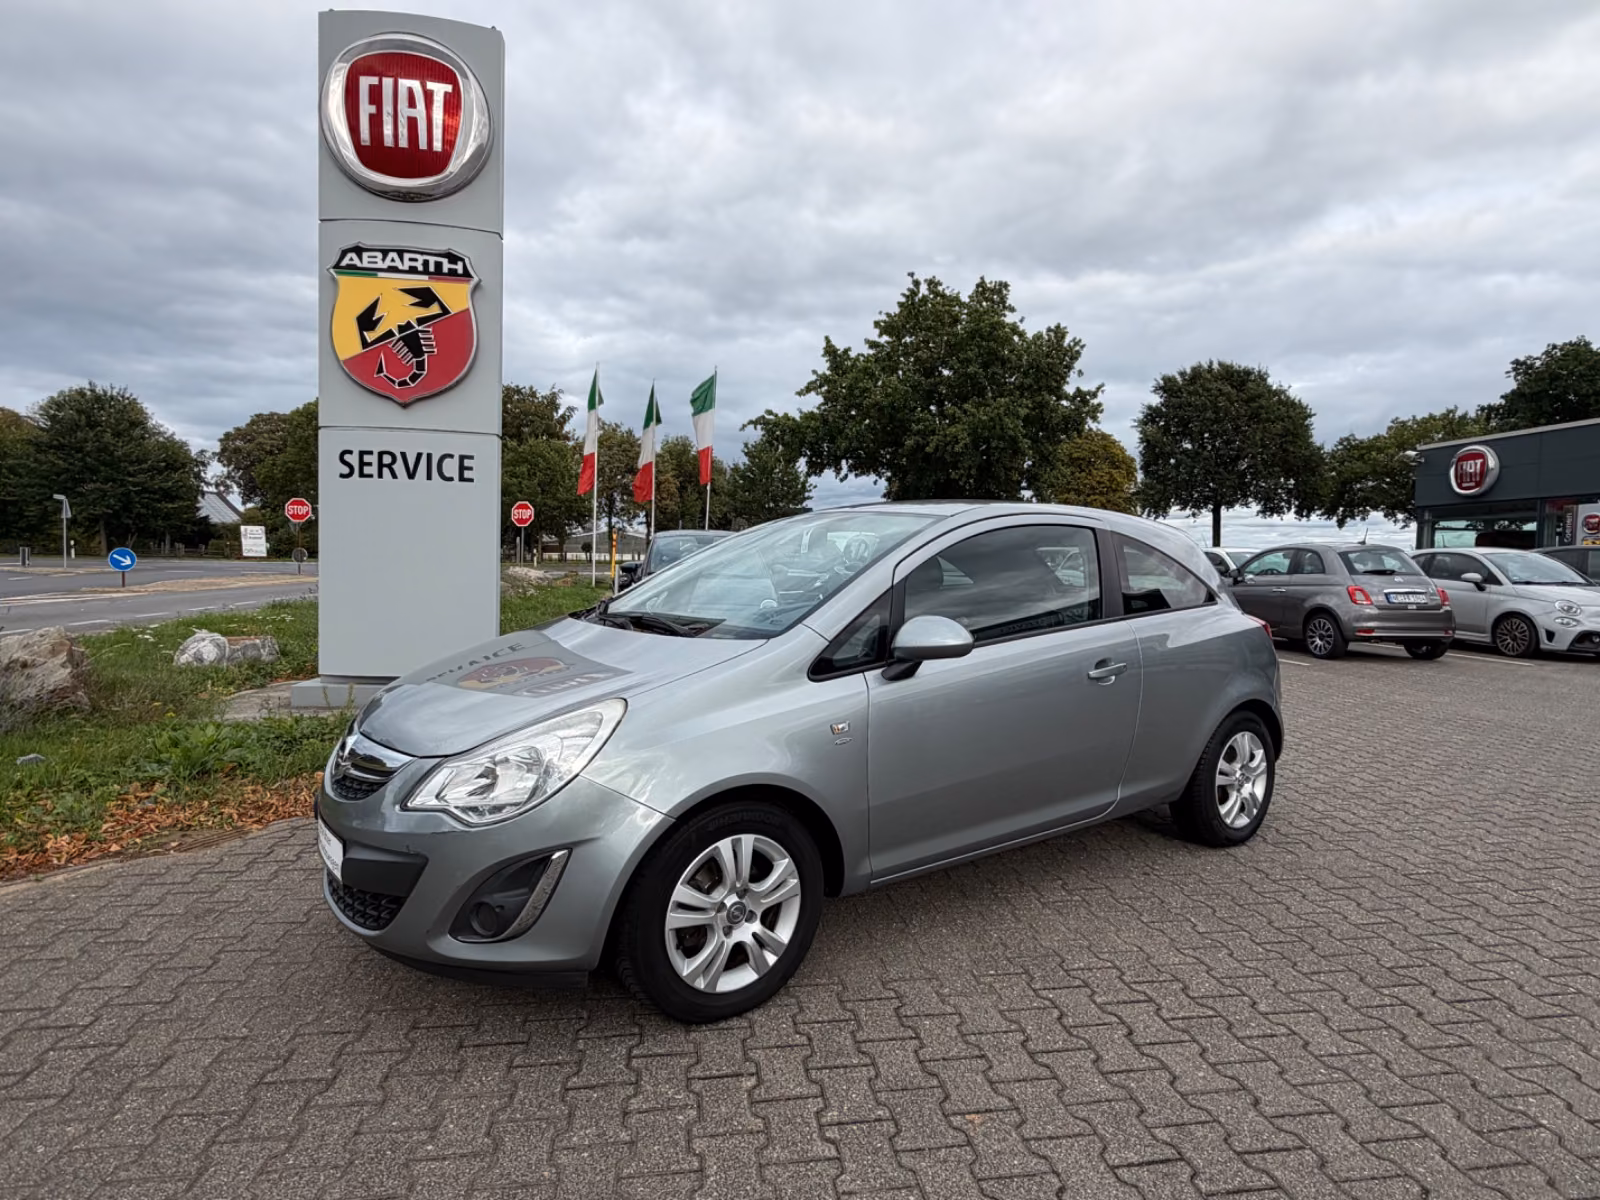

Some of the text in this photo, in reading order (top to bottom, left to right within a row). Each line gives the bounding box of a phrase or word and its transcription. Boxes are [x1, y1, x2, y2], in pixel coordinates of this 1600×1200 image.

[359, 76, 453, 152] FIAT
[340, 251, 464, 274] ABARTH
[338, 449, 475, 483] SERVICE
[1457, 459, 1483, 483] FIAT
[288, 505, 309, 515] STOP
[513, 508, 532, 519] STOP
